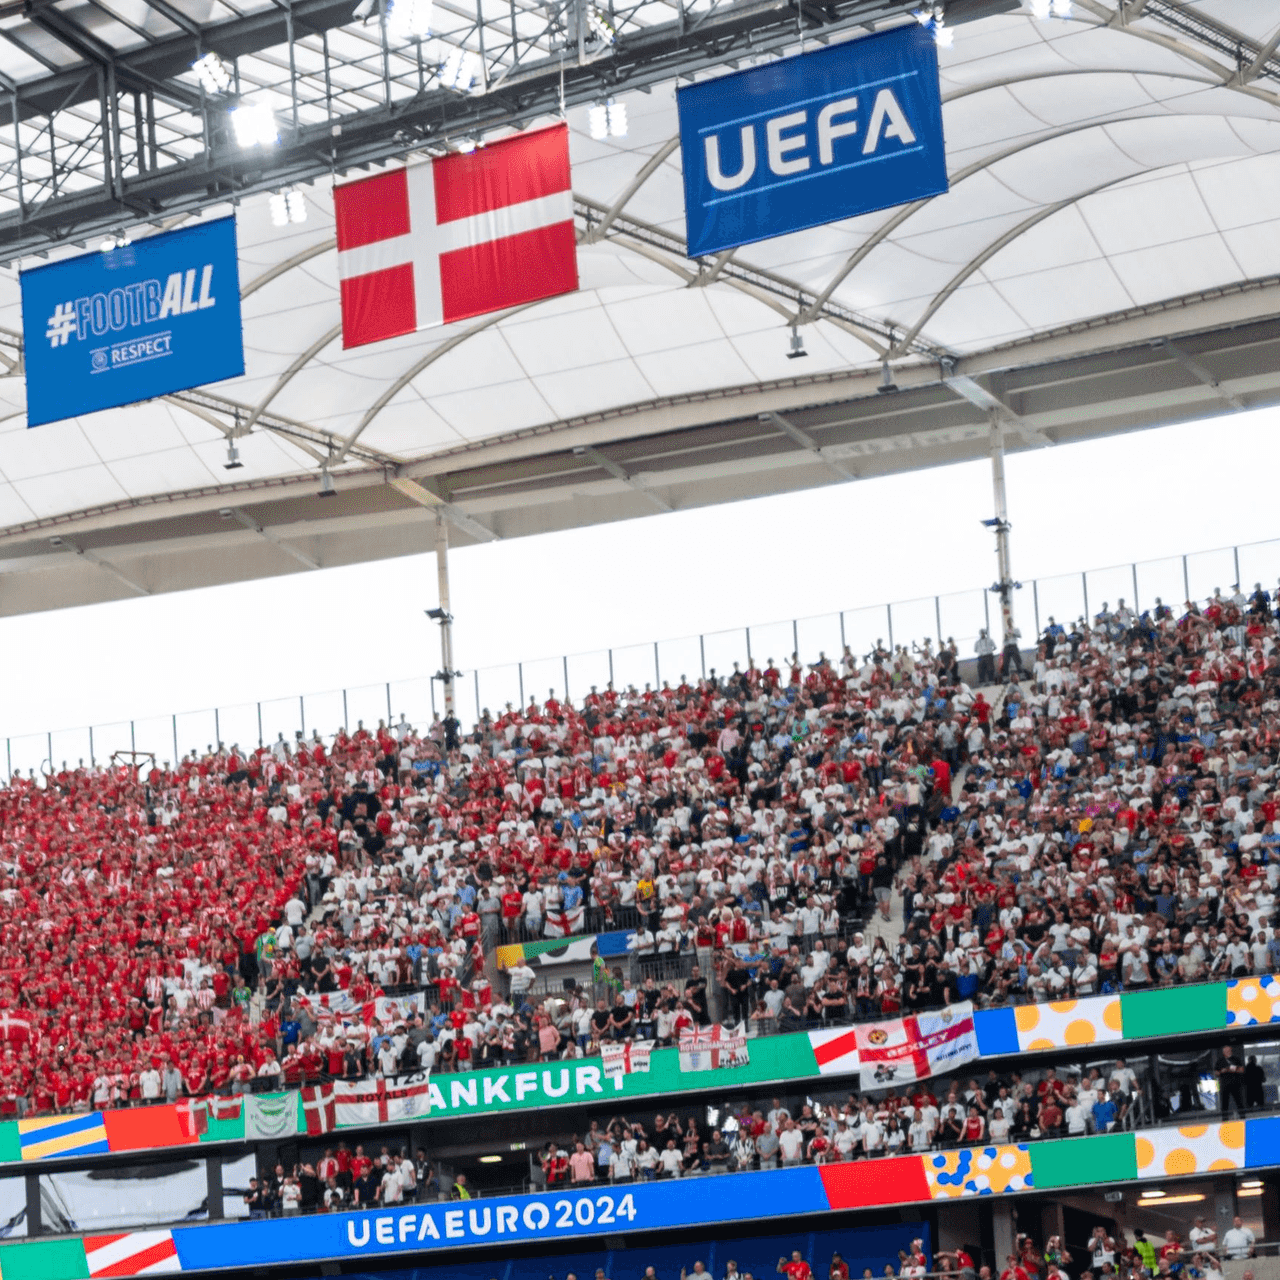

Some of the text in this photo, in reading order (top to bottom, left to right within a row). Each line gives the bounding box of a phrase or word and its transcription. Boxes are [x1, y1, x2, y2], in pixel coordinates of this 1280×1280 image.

[704, 88, 916, 191] UEFA
[45, 264, 215, 348] #FOOTBALL
[111, 335, 172, 363] RESPECT
